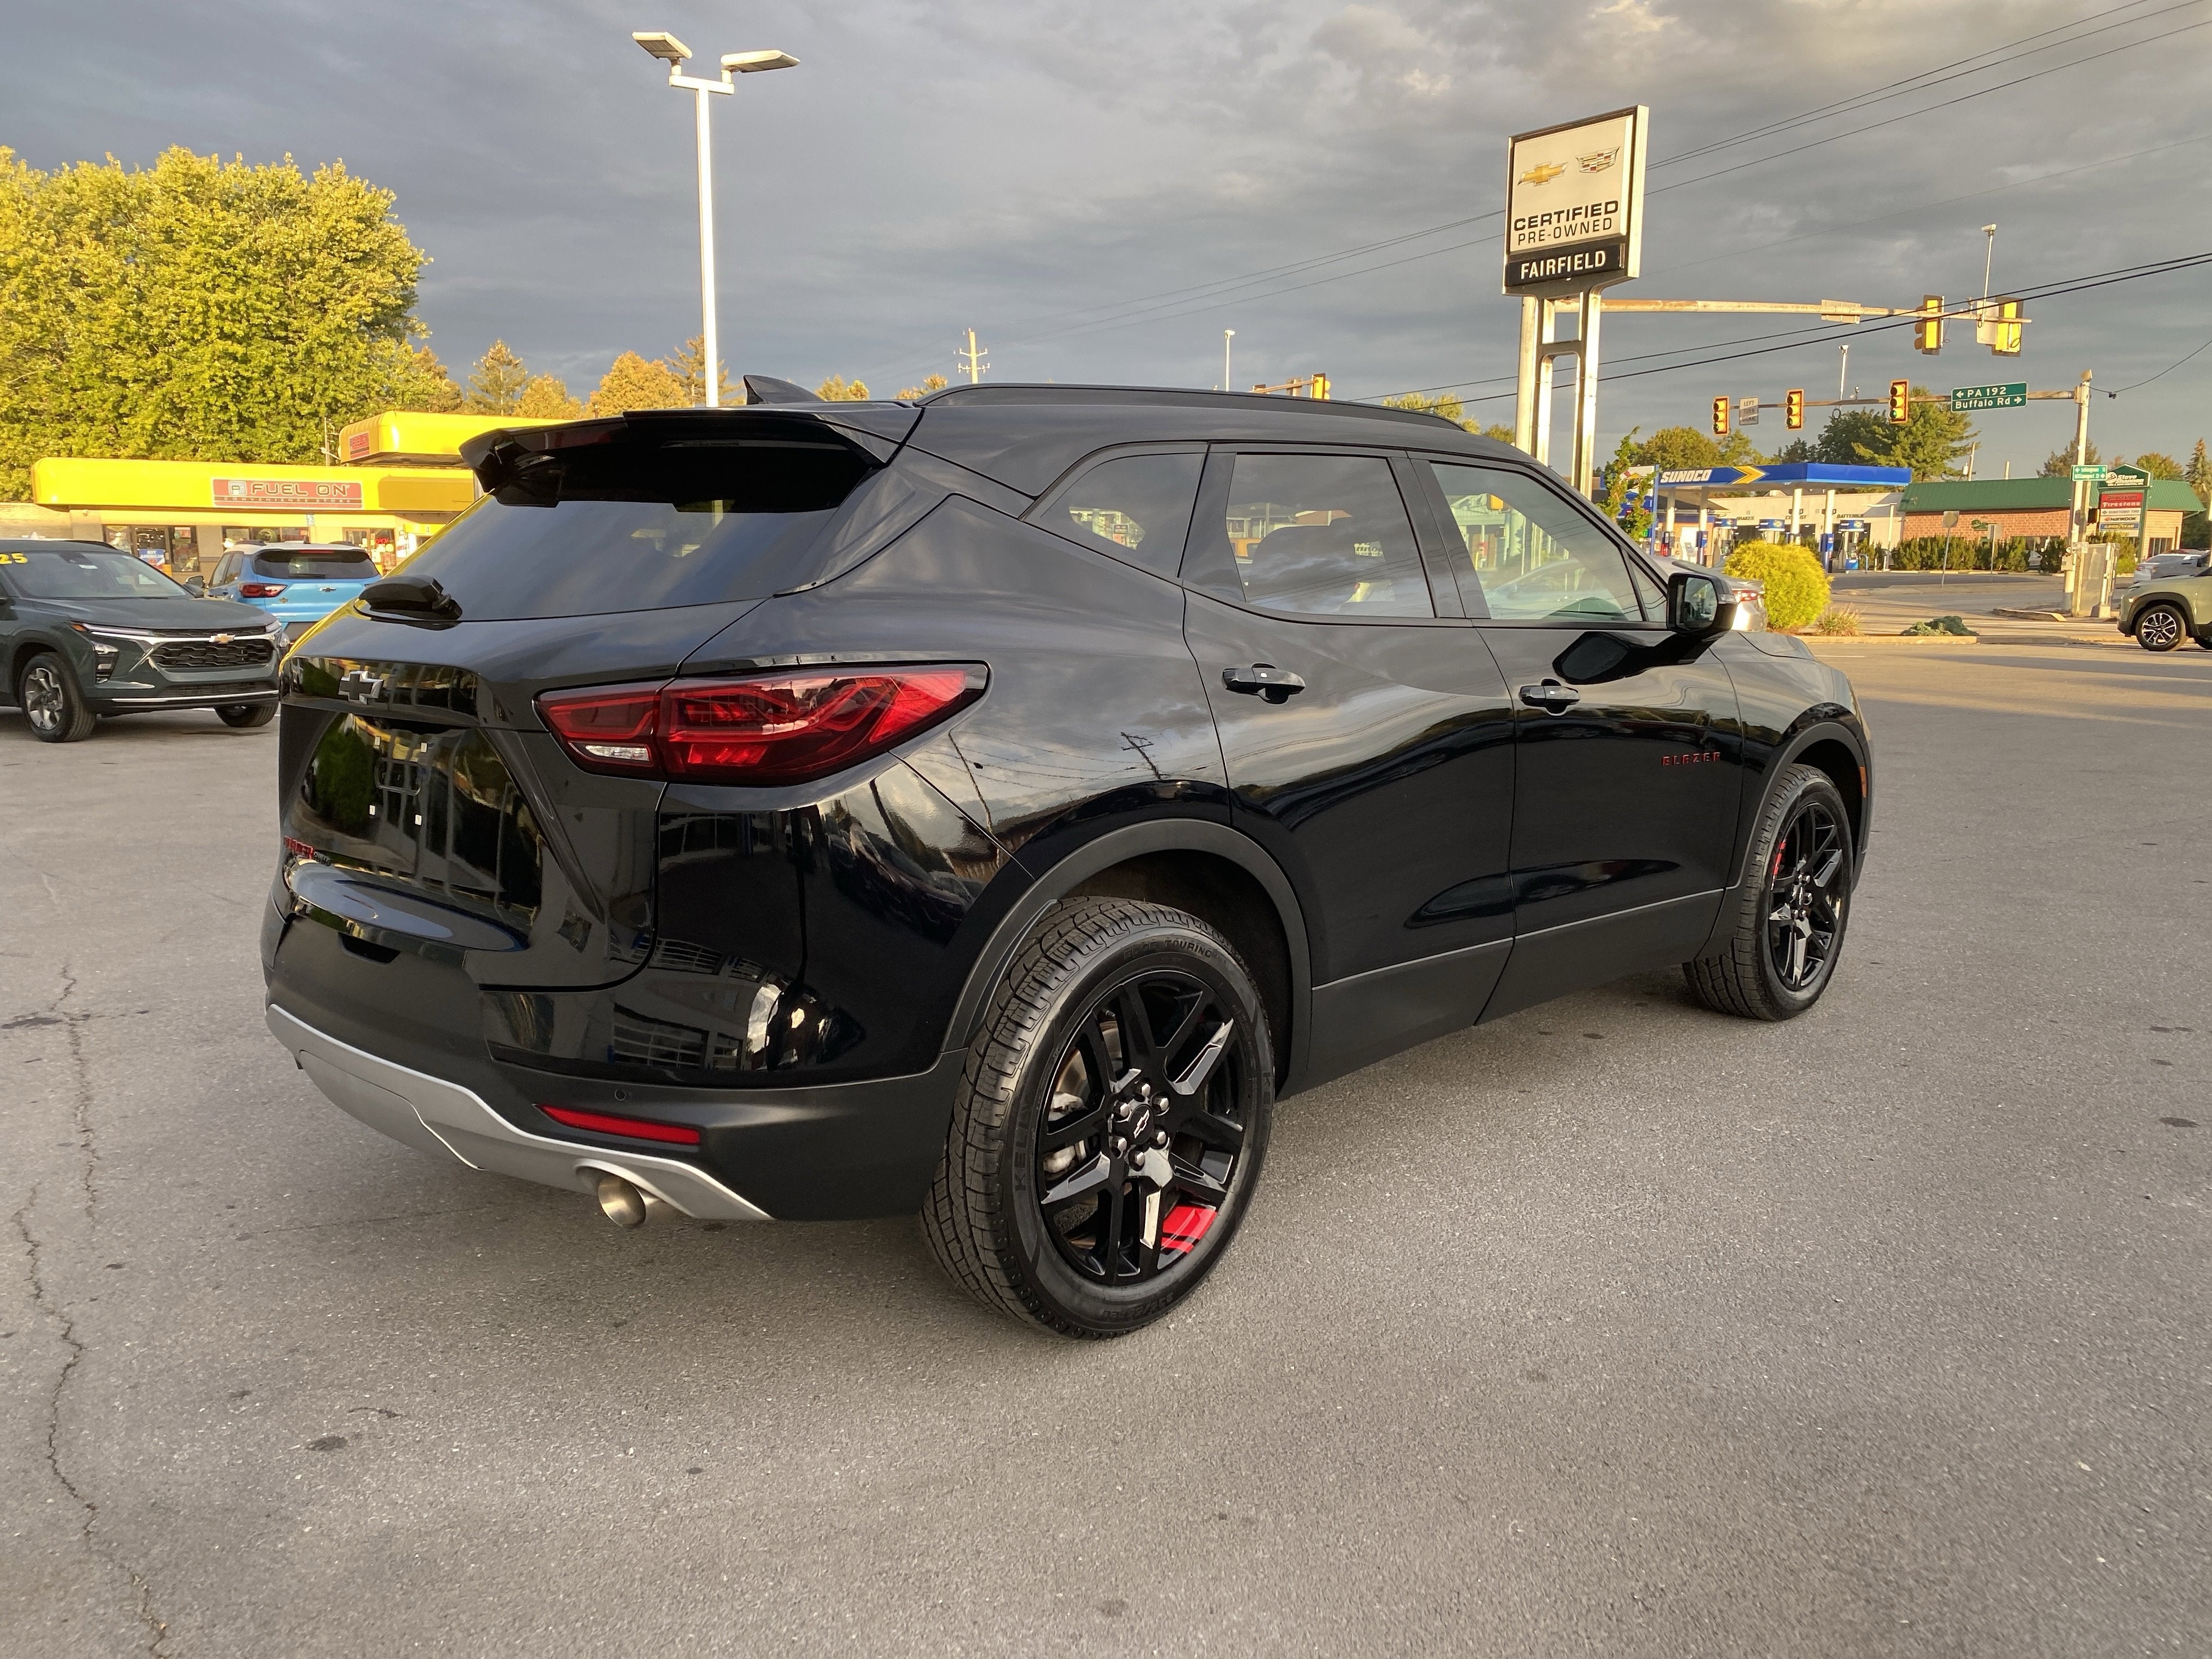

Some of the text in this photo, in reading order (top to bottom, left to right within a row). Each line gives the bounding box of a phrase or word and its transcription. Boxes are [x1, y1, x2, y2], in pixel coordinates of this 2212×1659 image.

[1514, 200, 1618, 231] CERTIFIED
[1518, 217, 1612, 245] PRE-OWNED
[1521, 250, 1606, 279] FAIRFIELD
[1967, 386, 2006, 398] PA 192
[1955, 397, 2011, 409] Buffalo Rd
[1660, 469, 1712, 483] SUNOCO
[251, 483, 349, 496] FUEL ON
[1662, 752, 1721, 766] BLAZER
[1164, 940, 1212, 958] TOURING
